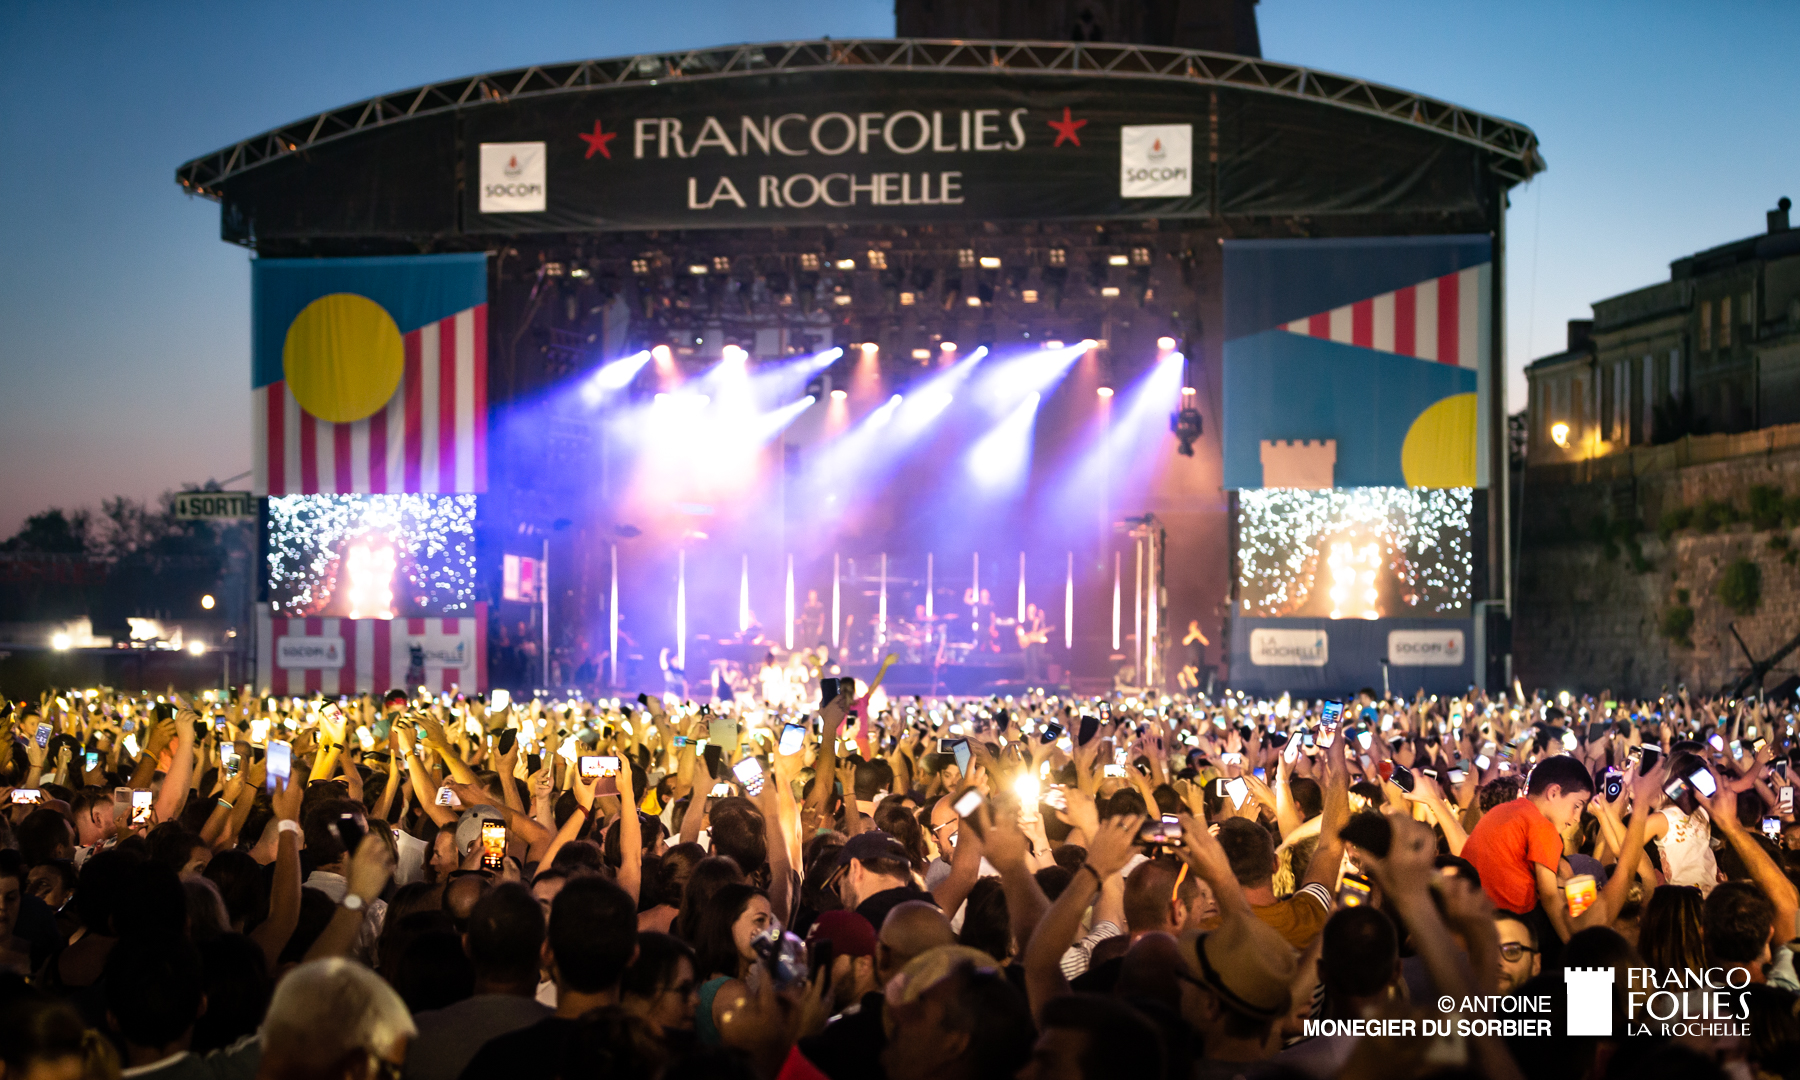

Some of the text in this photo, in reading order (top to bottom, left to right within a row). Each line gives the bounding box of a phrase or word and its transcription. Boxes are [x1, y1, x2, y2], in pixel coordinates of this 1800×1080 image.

[633, 109, 1028, 159] FRANCOFOLIES
[688, 172, 964, 209] LA ROCHELLE
